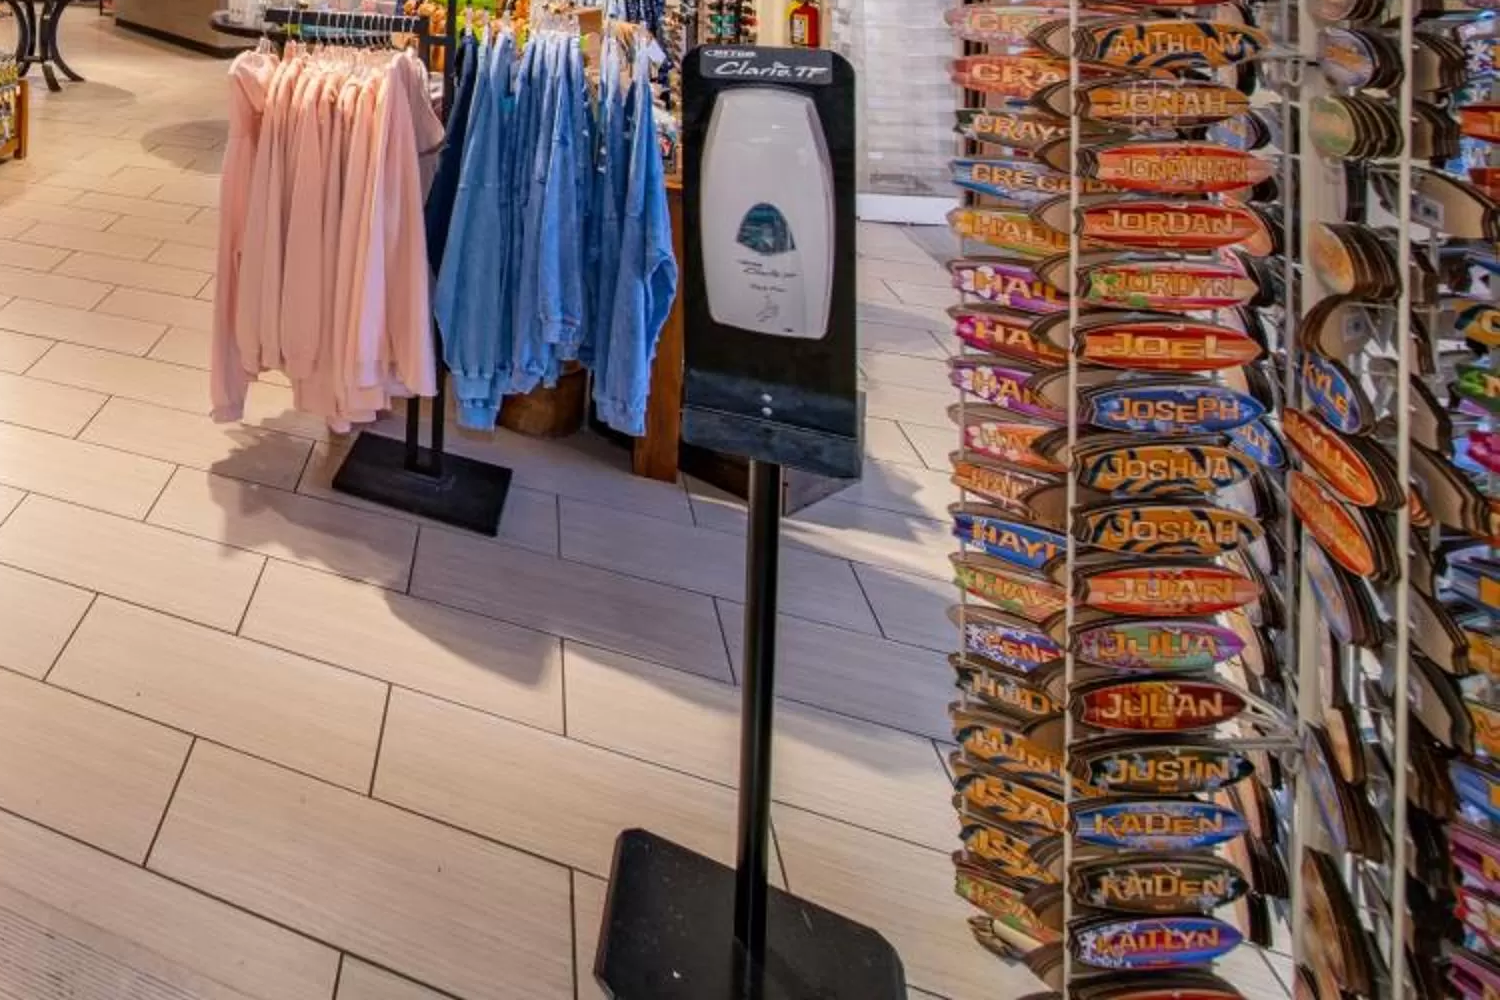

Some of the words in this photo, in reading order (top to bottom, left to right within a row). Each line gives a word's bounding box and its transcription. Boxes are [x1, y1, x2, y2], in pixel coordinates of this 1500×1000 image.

[1113, 31, 1243, 56] ANTHONY
[1102, 209, 1235, 236] JORDAN
[1104, 332, 1233, 360] JOEL
[1108, 397, 1240, 423] JOSEPH
[1103, 455, 1234, 481] JOSHUA
[1105, 511, 1240, 544] JOSIAH
[1102, 577, 1234, 602] JUAN
[1100, 691, 1224, 719] JULIAN
[1105, 756, 1229, 784] JUSTIN
[1094, 811, 1224, 838] KADEN
[1100, 874, 1226, 900] KAIDEN
[1095, 927, 1220, 955] KAITLYN
